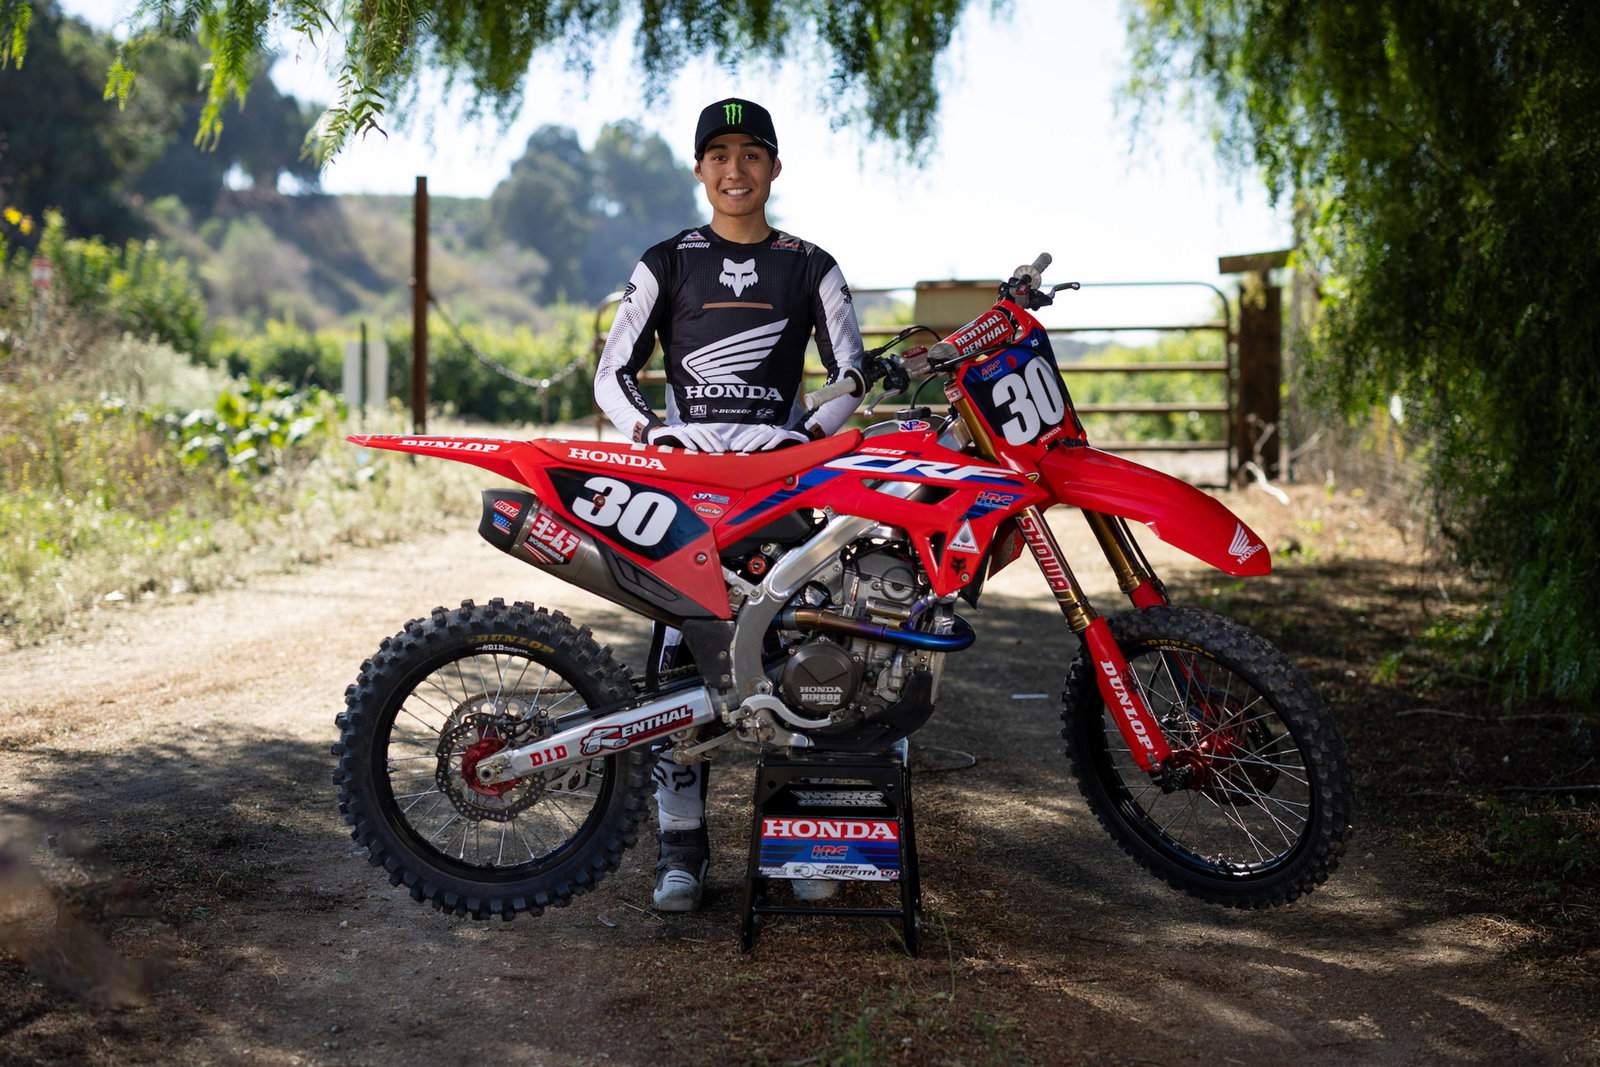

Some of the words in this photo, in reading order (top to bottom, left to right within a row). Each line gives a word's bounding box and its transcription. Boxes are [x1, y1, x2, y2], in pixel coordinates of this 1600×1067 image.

[676, 241, 711, 250] SHOWA
[954, 313, 1003, 347] RENTHAL
[961, 323, 1009, 356] RENTHAL
[684, 384, 784, 402] HONDA
[992, 356, 1065, 446] 30
[1040, 426, 1062, 443] HONDA
[398, 440, 500, 452] DUNLOP
[568, 447, 667, 471] HONDA
[823, 455, 1019, 480] CRF
[974, 491, 1014, 507] HRC
[572, 476, 678, 547] 30
[531, 516, 580, 555] ヨシムラ
[527, 535, 565, 563] YOSHIMURA
[1015, 515, 1072, 596] SHOWA
[1236, 543, 1264, 565] HONDA
[475, 634, 555, 654] DUNLOP
[1146, 639, 1216, 658] DUNLOP
[1100, 660, 1154, 751] DUNLOP
[790, 791, 885, 800] WORKS
[763, 819, 898, 840] HONDA
[811, 845, 849, 857] HRC
